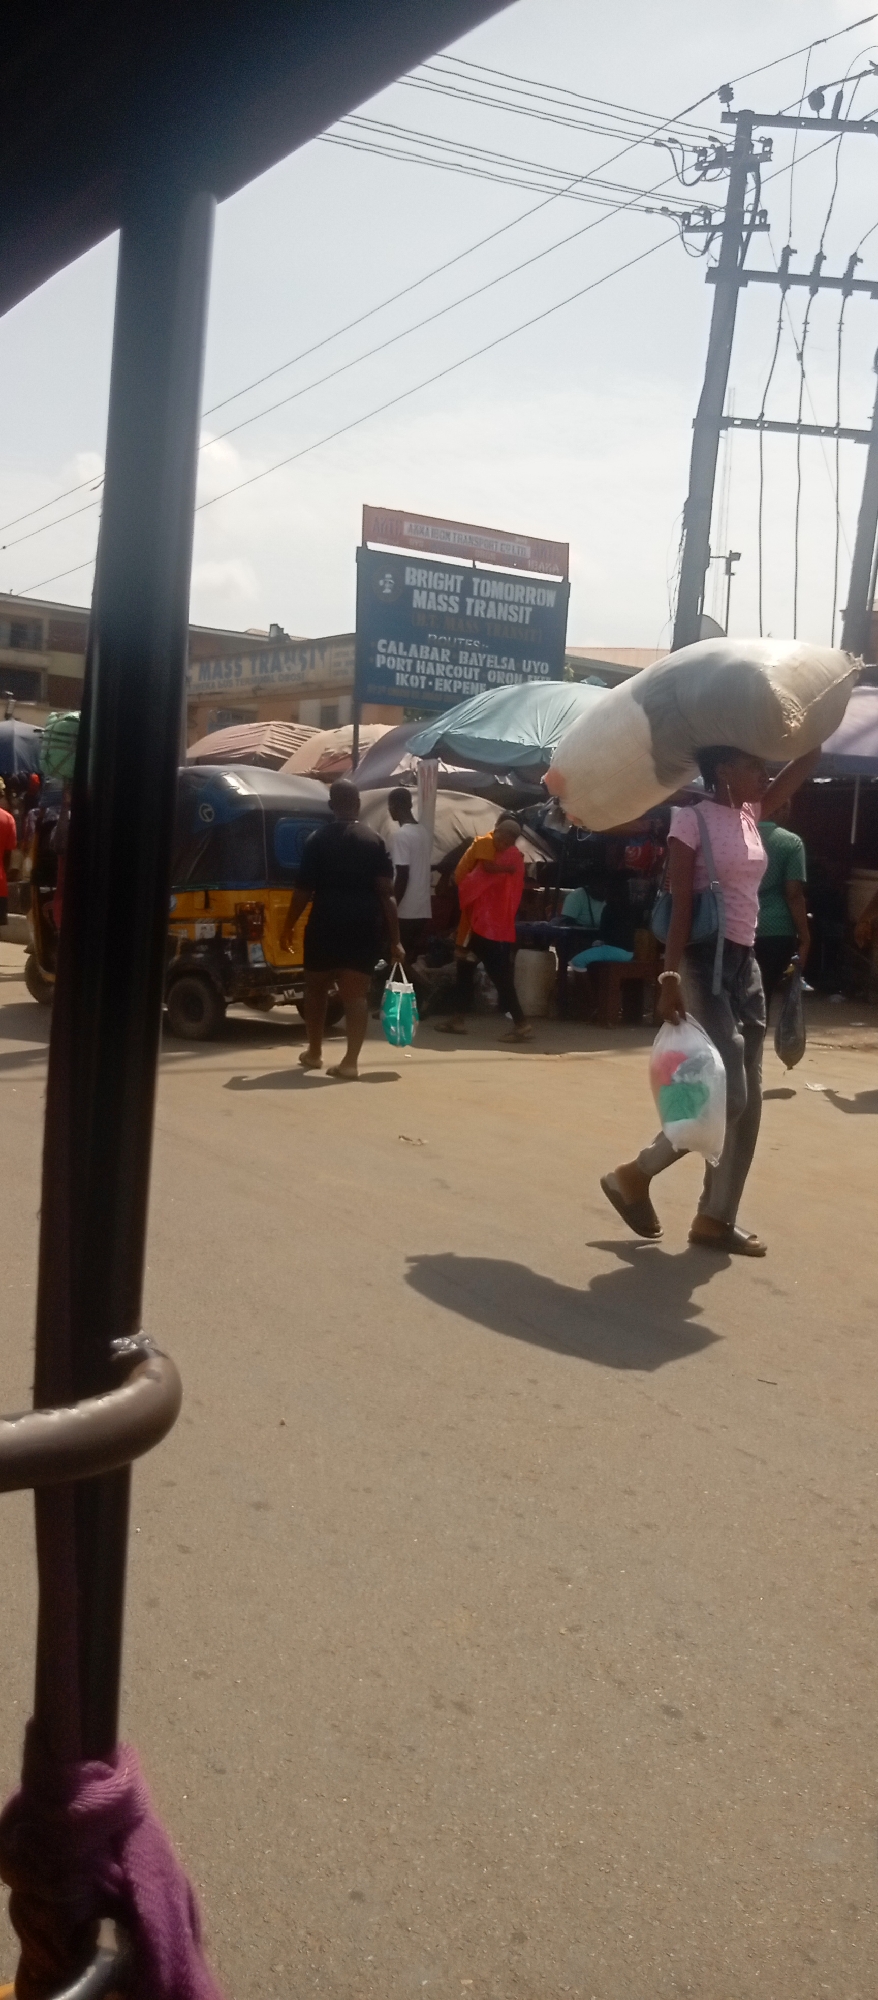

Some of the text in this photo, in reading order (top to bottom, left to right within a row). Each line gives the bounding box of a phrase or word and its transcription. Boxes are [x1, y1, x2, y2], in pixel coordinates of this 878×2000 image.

[452, 532, 498, 551] TRANSPORT
[404, 566, 557, 608] BRIGHT TOMORROW
[412, 589, 533, 624] MASS TRANSIT
[198, 655, 243, 681] MASS
[249, 645, 328, 676] TRANSIT
[375, 654, 413, 672] PORT
[416, 660, 480, 681] HARCOUT
[487, 669, 523, 684] ORON
[376, 638, 549, 675] CALABAR BAYELSA UYO
